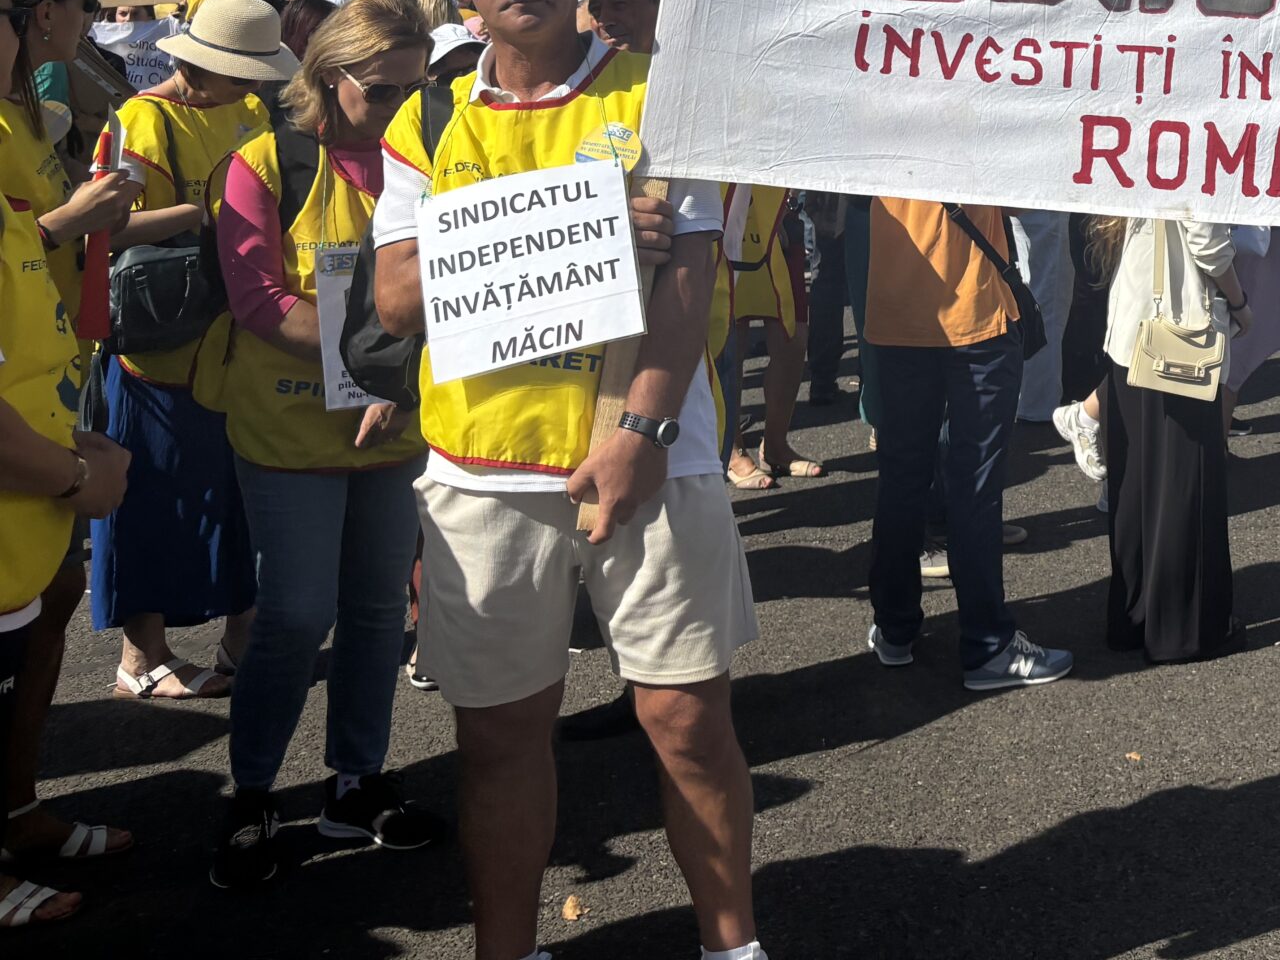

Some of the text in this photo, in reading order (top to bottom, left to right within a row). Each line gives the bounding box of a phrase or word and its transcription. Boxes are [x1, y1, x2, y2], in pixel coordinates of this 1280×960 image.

[1219, 34, 1273, 100] ÎN
[438, 180, 598, 233] SINDICATUL
[429, 216, 619, 280] INDEPENDENT
[430, 258, 621, 323] ÎNVĂȚĂMÂNT
[491, 319, 583, 363] MĂCIN
